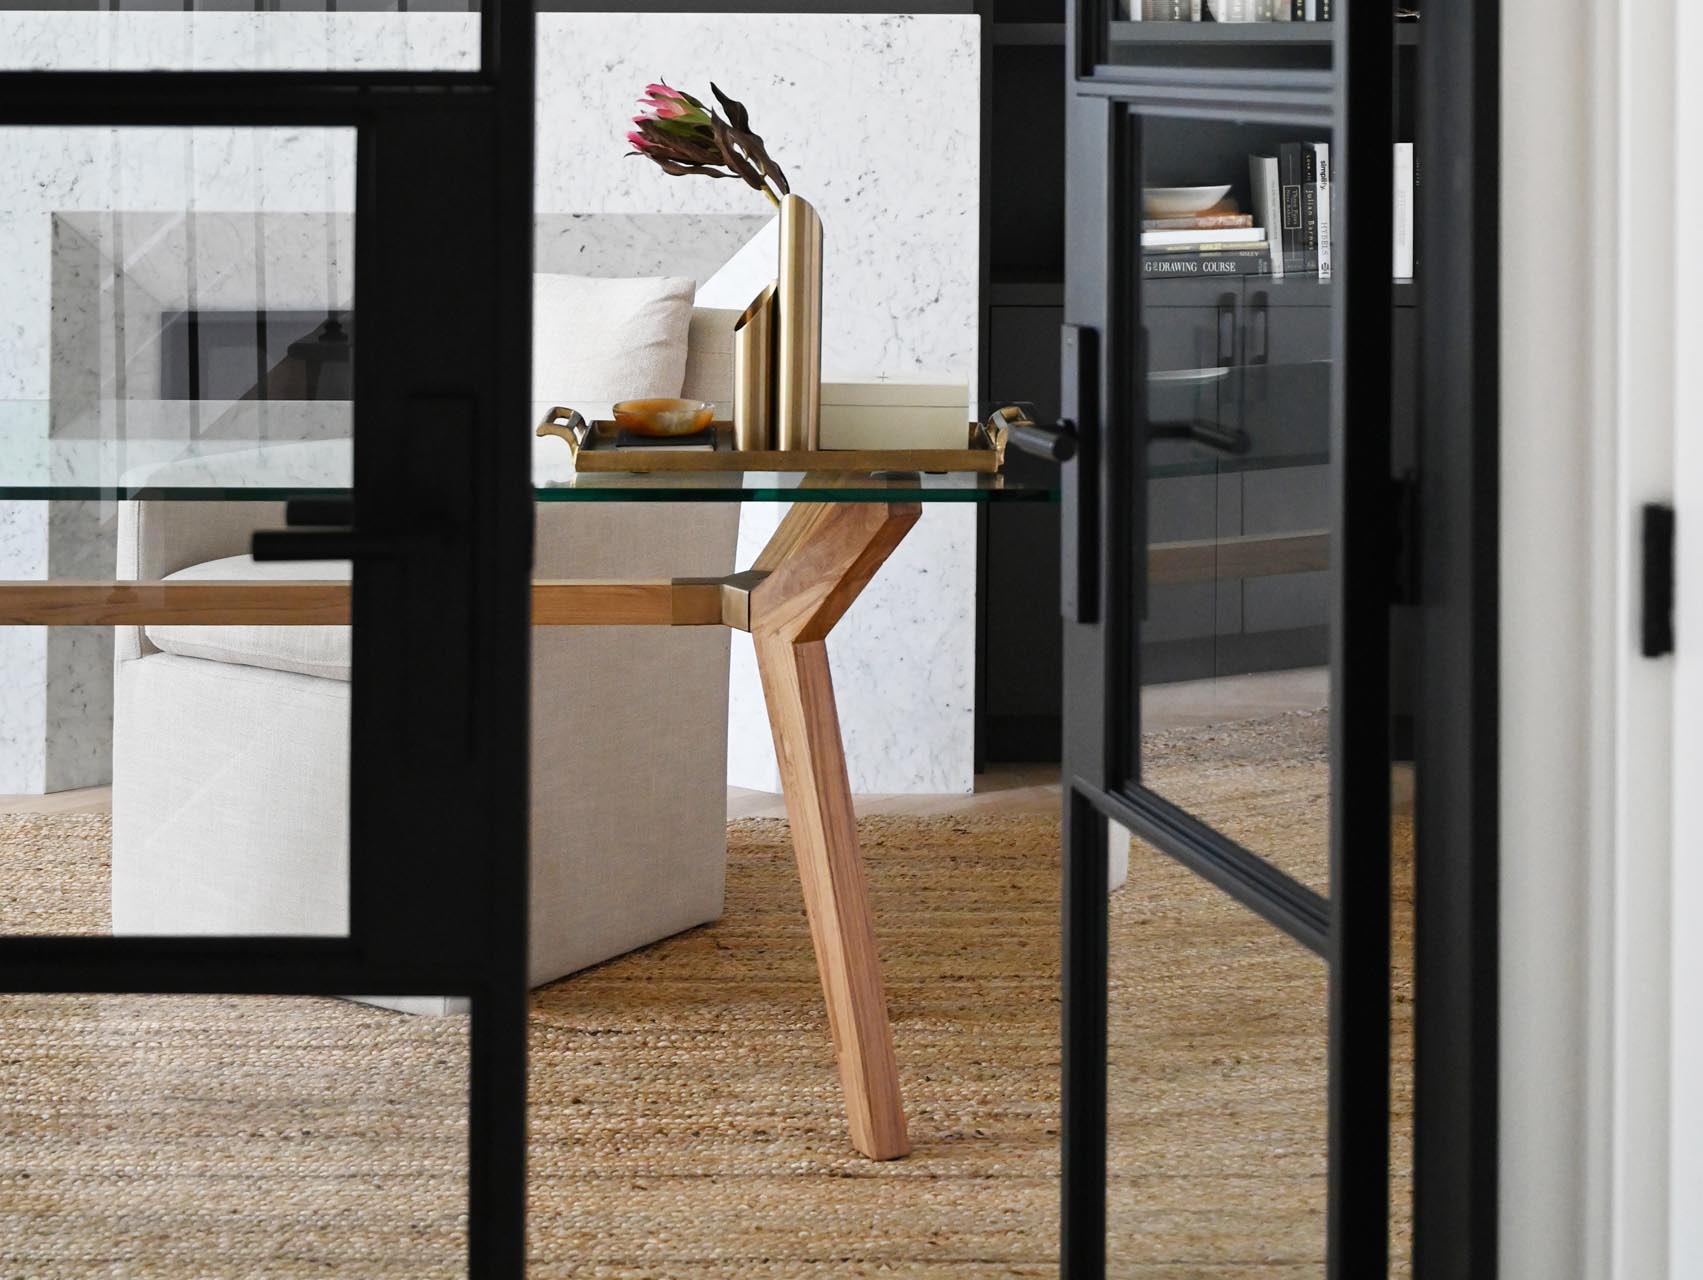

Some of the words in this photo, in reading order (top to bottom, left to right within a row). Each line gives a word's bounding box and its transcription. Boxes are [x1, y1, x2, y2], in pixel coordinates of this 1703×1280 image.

[1319, 160, 1329, 191] simplify.
[1305, 189, 1315, 217] Julian
[1307, 220, 1316, 252] Barnes
[1319, 222, 1329, 256] HYBELS
[1159, 261, 1198, 272] DRAWING
[1202, 261, 1238, 272] COURSE
